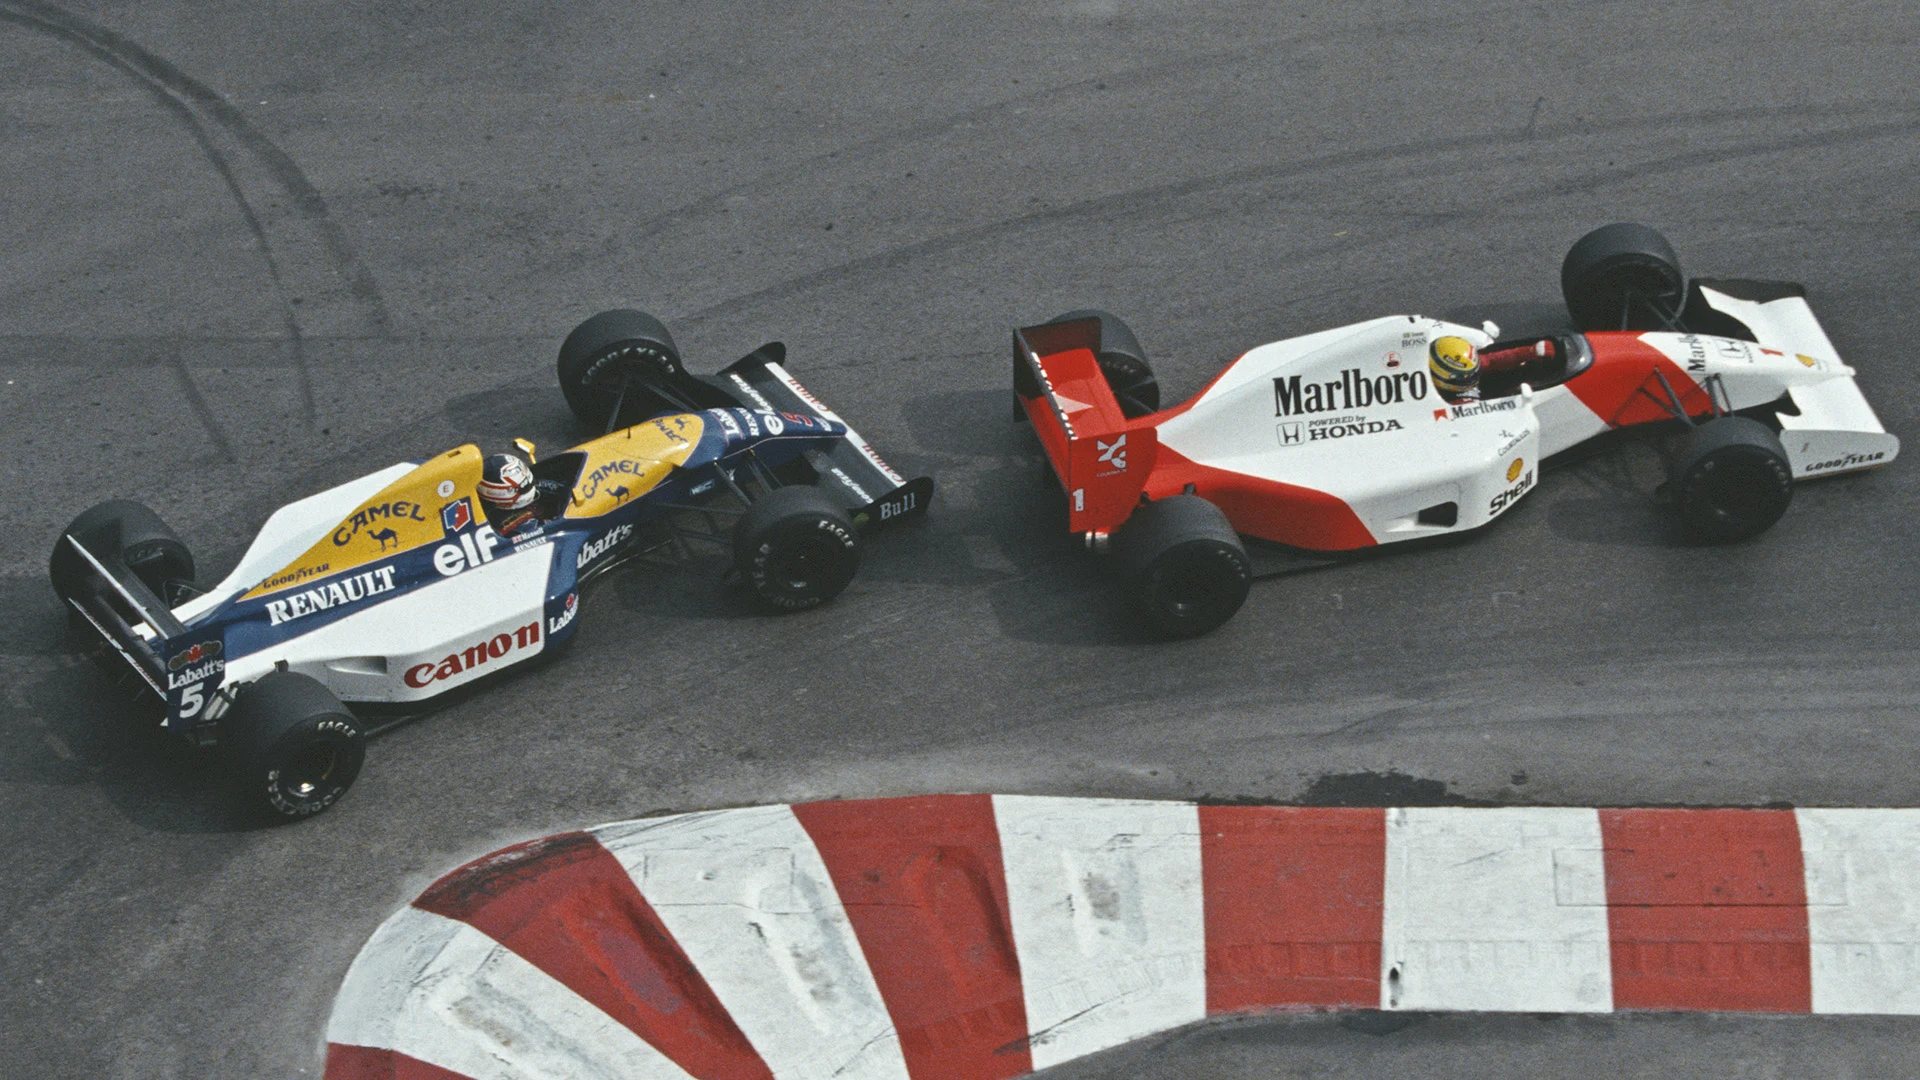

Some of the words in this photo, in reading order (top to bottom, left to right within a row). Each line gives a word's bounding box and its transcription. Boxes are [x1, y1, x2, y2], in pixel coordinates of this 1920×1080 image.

[1272, 368, 1428, 418] Marlboro
[1308, 416, 1354, 428] POWERED
[1355, 414, 1367, 423] by
[1451, 399, 1517, 419] Marlboro
[1308, 419, 1405, 441] HONDA
[1805, 451, 1885, 472] GOODYEAR
[582, 460, 645, 499] CAMEL
[1489, 469, 1533, 516] Shell
[880, 492, 916, 520] Bull
[1072, 488, 1084, 511] 1
[333, 501, 426, 547] CAMEL
[818, 520, 854, 548] EAGLE
[433, 524, 499, 576] elf
[263, 562, 330, 589] GOODYEAR
[265, 565, 396, 626] RENAULT
[404, 621, 539, 688] Canon
[168, 659, 224, 690] Labatt's
[179, 682, 204, 718] 5
[317, 720, 356, 738] EAGLE
